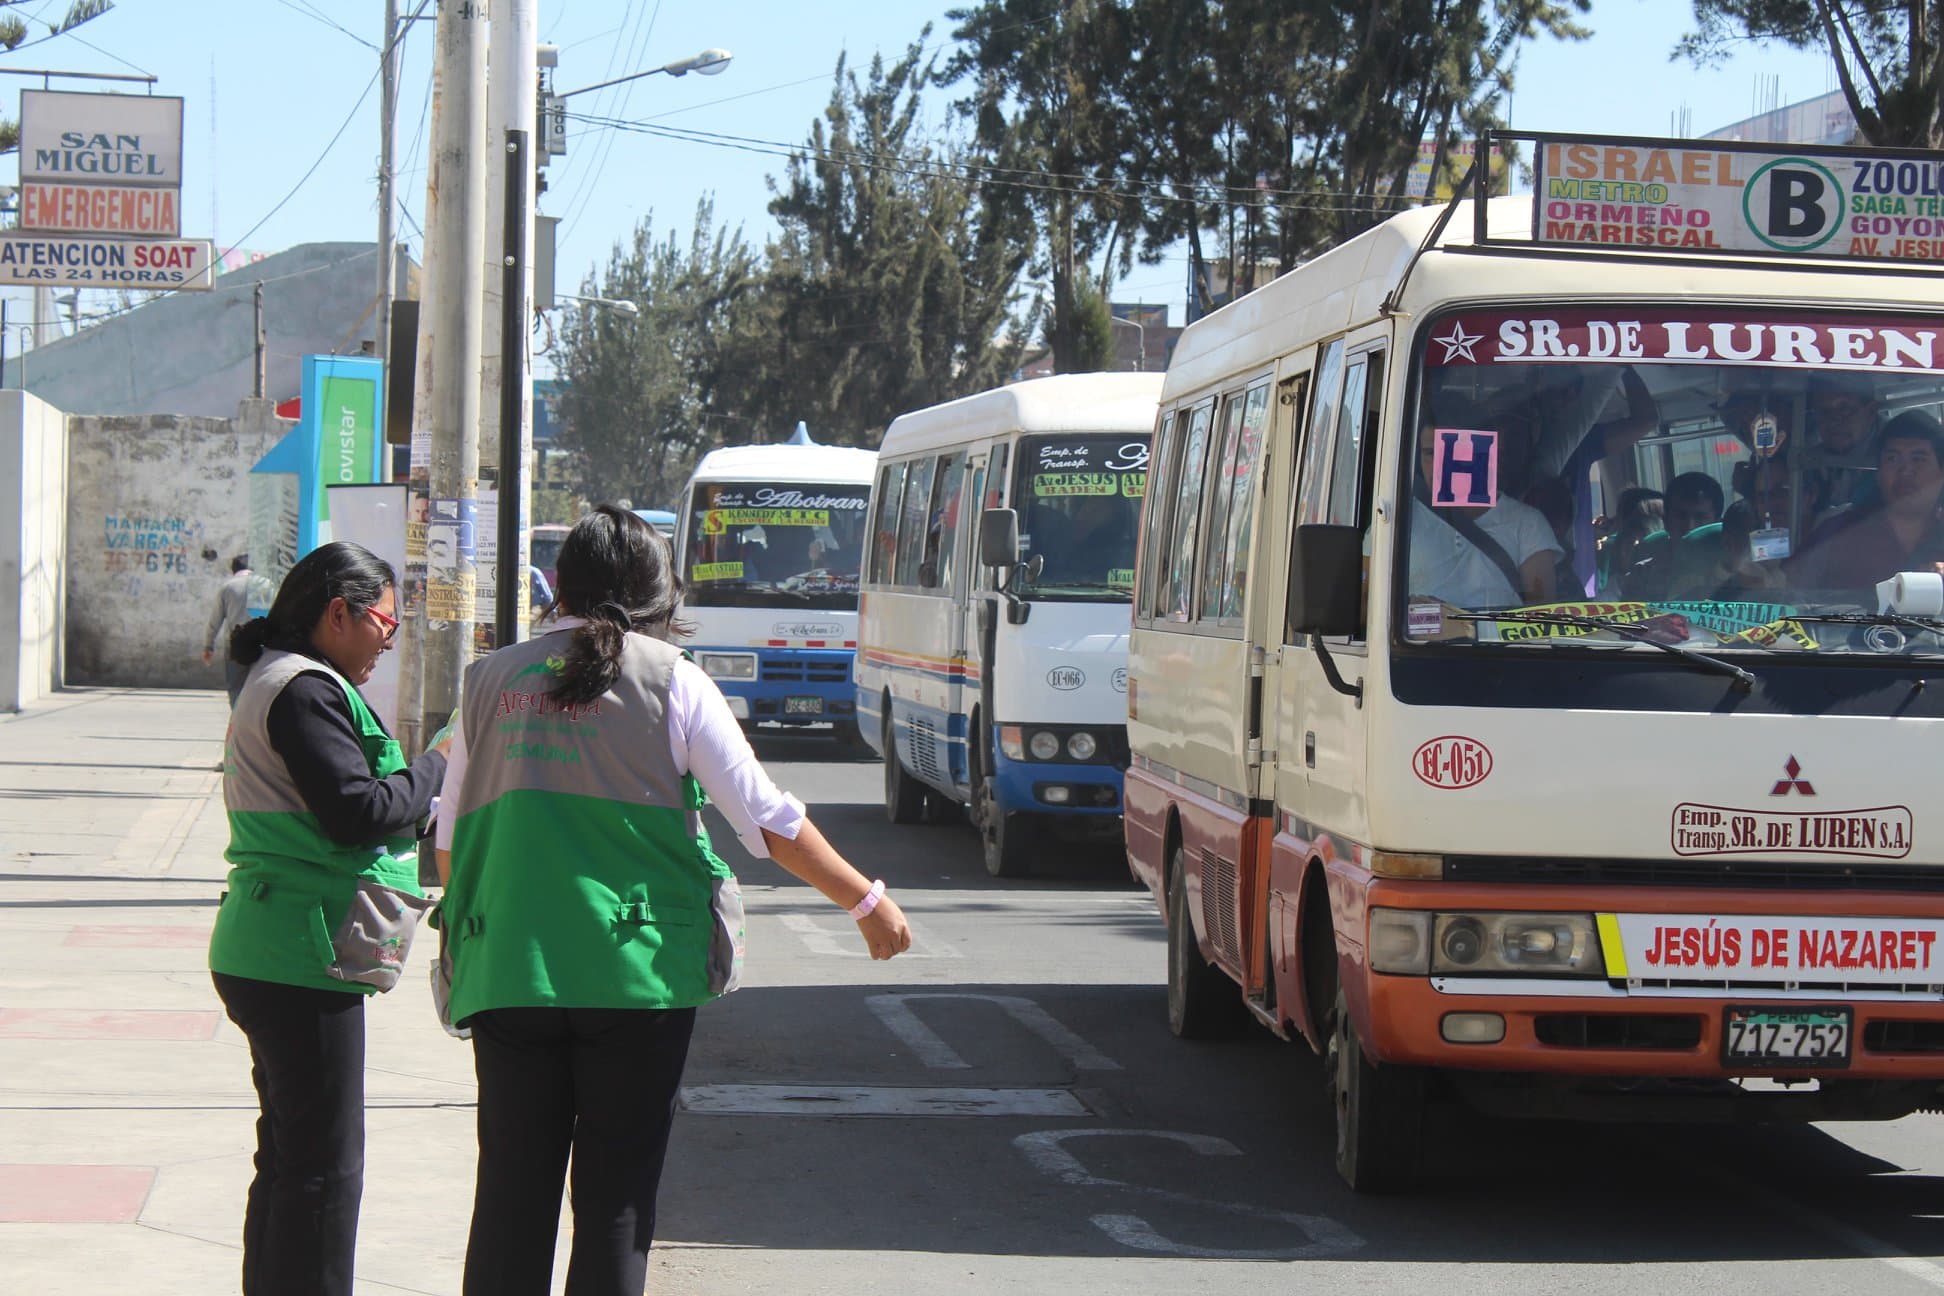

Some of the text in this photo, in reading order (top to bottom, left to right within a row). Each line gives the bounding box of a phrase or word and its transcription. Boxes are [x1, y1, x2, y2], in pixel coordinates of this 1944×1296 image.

[61, 132, 140, 150] SAN
[36, 149, 164, 175] MIGUEL
[1547, 144, 1745, 188] ISRAEL
[1548, 178, 1669, 204] METRO
[1768, 168, 1826, 237] B
[1851, 194, 1907, 215] SAGA
[24, 186, 175, 231] EMERGENCIA
[1547, 201, 1711, 228] ORMEÑO
[1546, 221, 1721, 248] MARISCAL
[1848, 237, 1882, 256] AV.
[1, 241, 196, 268] ATENCION SOAT
[12, 268, 184, 282] LAS 24 HORAS
[1499, 319, 1937, 368] SR. DE LUREN
[339, 405, 356, 482] ovistar
[1074, 446, 1088, 455] de
[1437, 432, 1492, 504] H
[1421, 741, 1484, 785] EC-051
[1679, 809, 1728, 828] Emp.
[1678, 816, 1909, 850] Transp. SR. DE LUREN S.A.
[1645, 919, 1937, 974] JESÚS DE NAZARET
[1730, 1024, 1844, 1057] Z1Z-752
